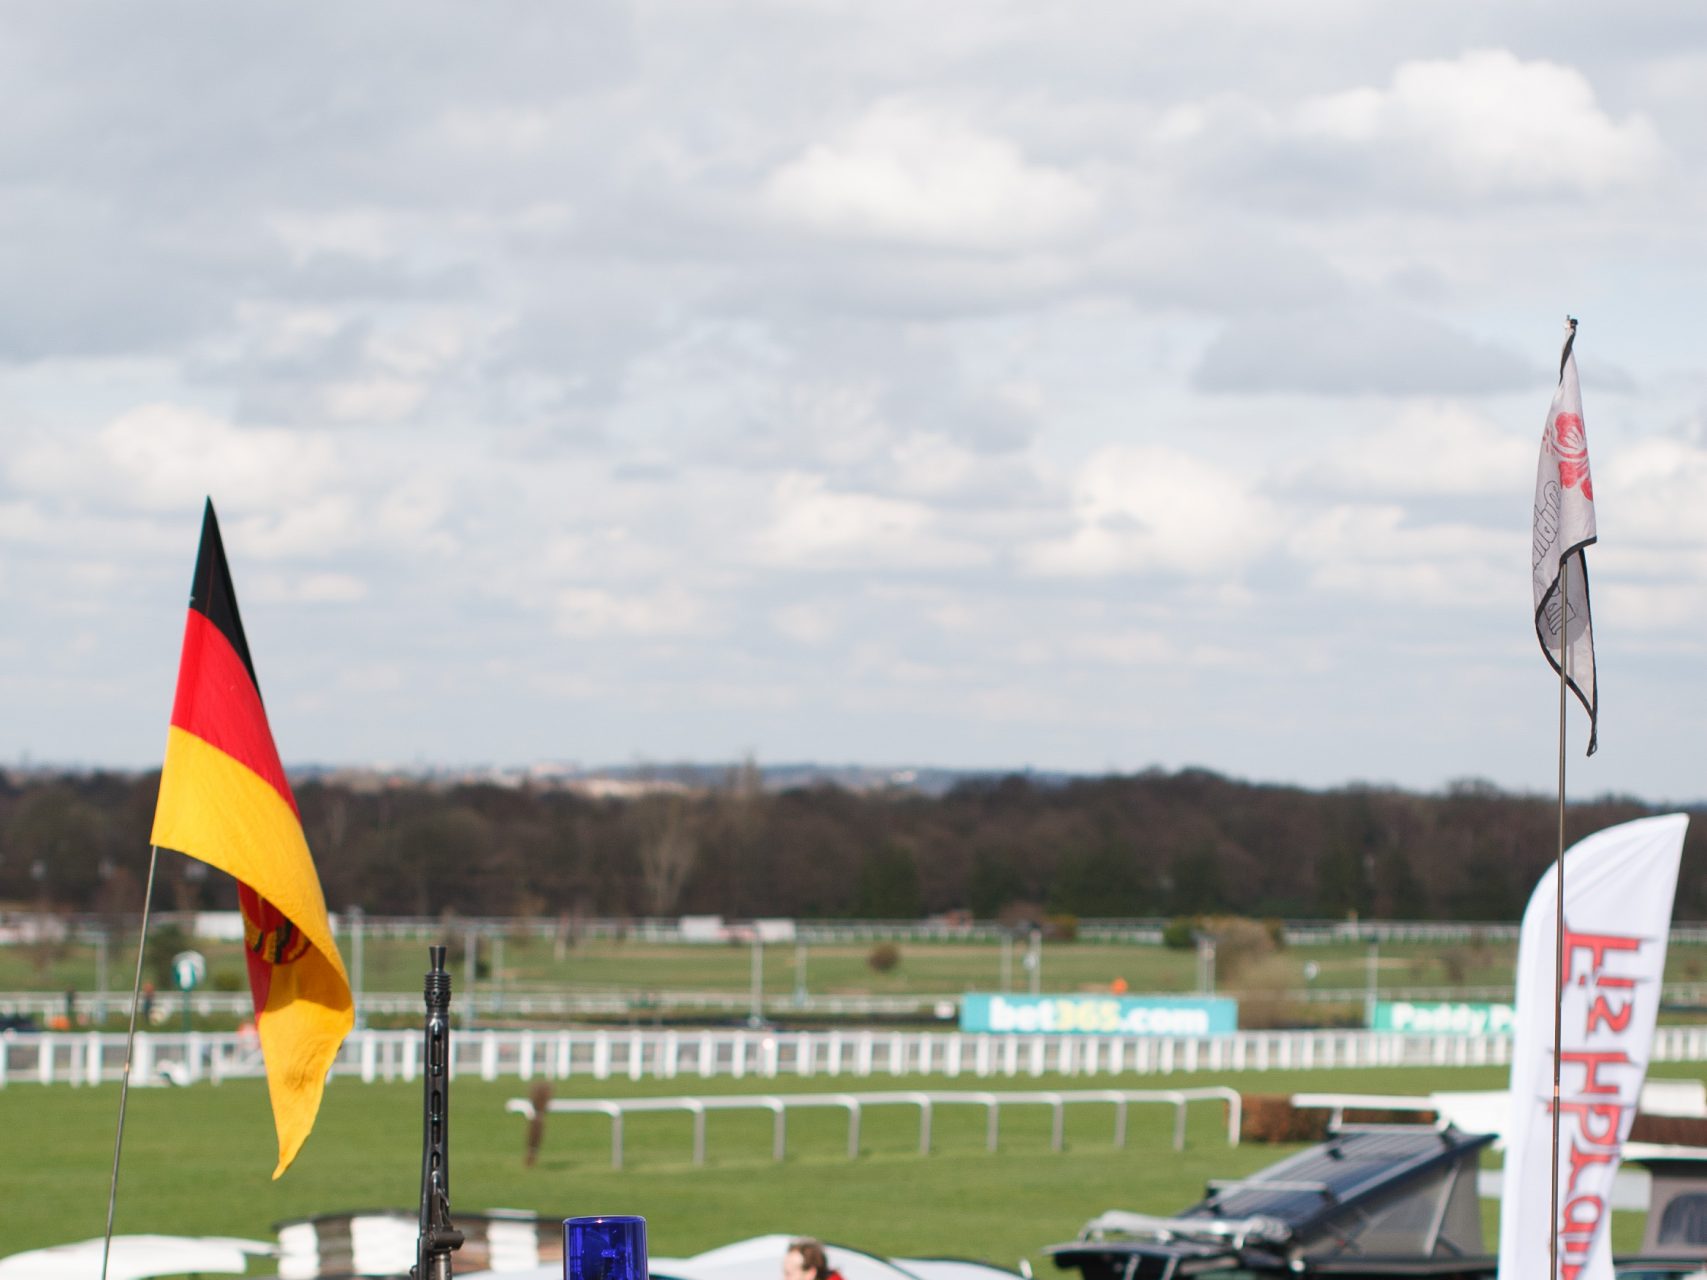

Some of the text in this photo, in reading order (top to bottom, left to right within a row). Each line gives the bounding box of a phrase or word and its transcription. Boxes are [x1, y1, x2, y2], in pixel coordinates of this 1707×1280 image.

[989, 996, 1209, 1033] bet365.com
[1392, 1003, 1518, 1036] Paddy P
